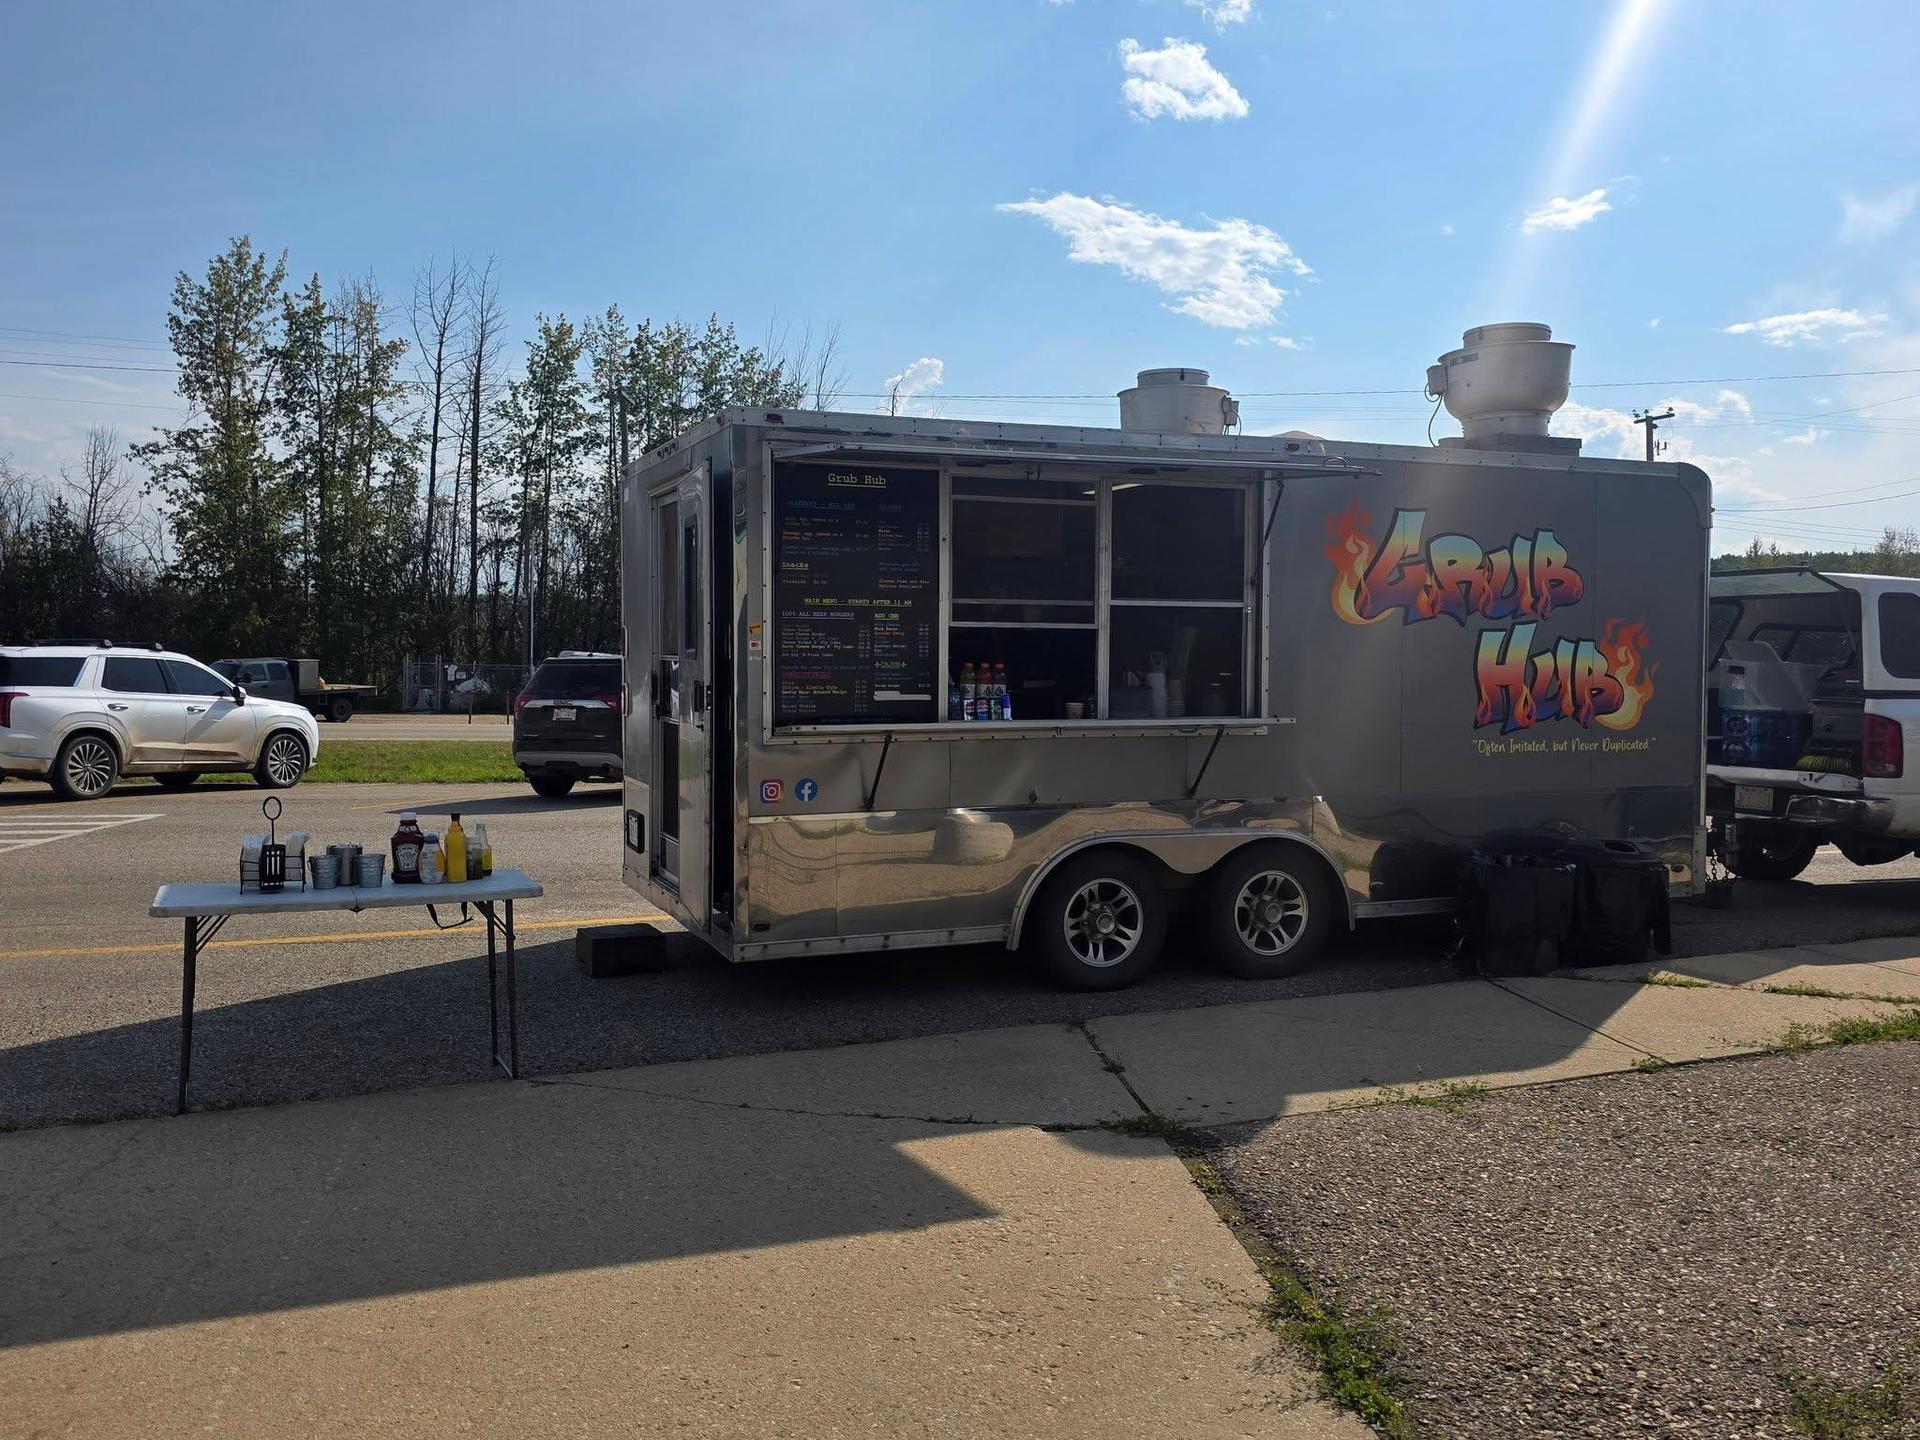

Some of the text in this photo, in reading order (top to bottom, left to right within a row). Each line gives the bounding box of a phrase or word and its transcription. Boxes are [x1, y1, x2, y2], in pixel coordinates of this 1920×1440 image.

[828, 473, 886, 485] Grub Hub
[1354, 508, 1584, 626] GRUB
[1473, 620, 1625, 735] HUB
[1509, 738, 1549, 752] Imitated,
[1552, 739, 1568, 752] but
[1571, 738, 1598, 752] Never
